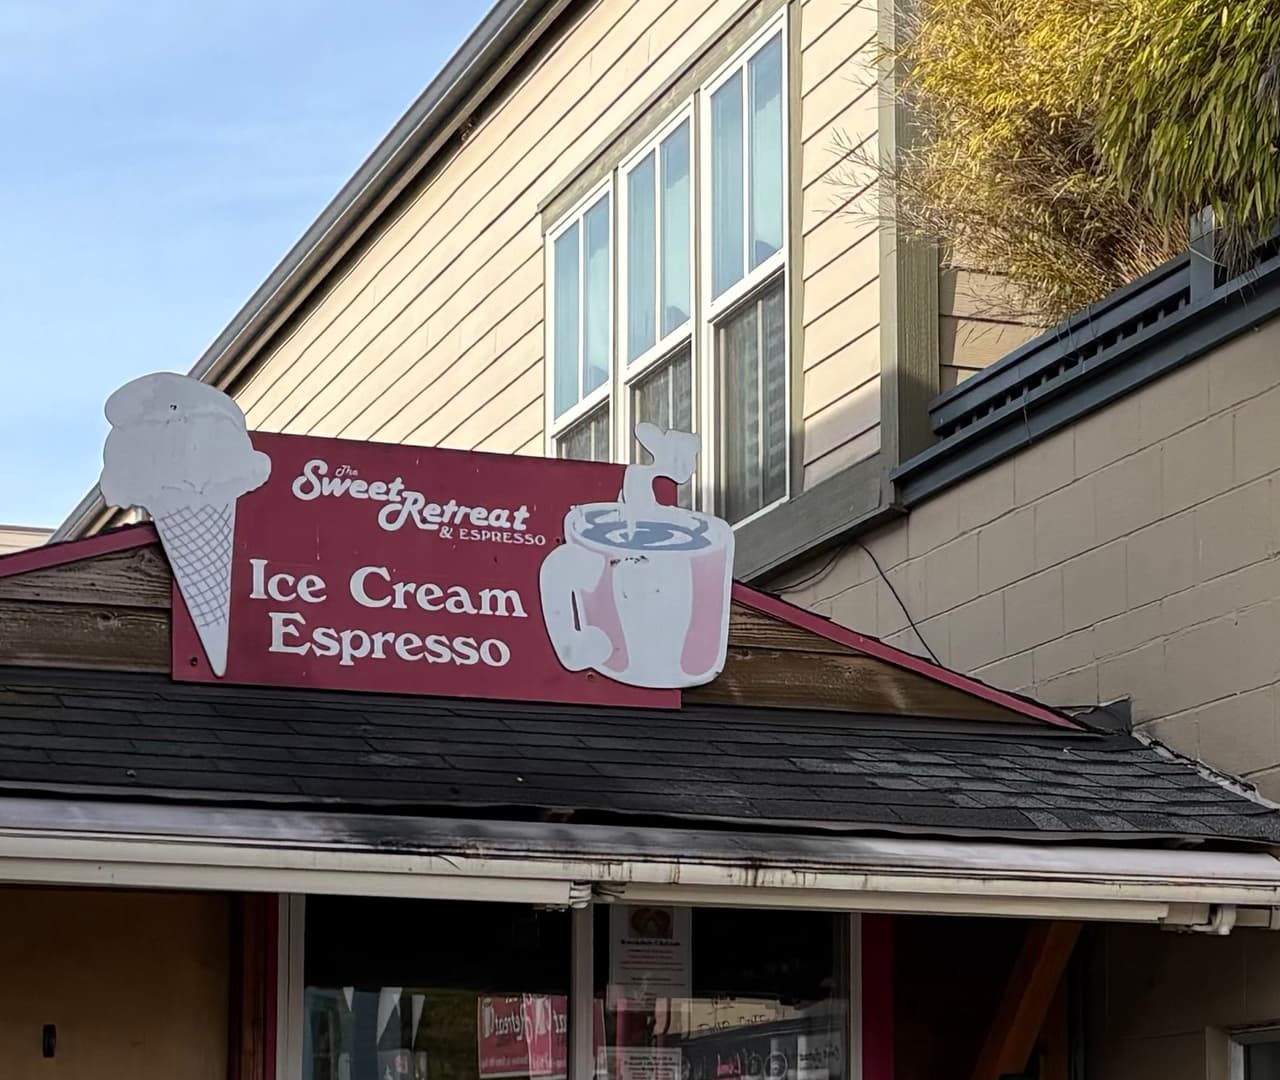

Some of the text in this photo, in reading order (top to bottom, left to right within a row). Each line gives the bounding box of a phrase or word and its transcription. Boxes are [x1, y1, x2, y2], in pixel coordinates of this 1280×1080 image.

[292, 459, 405, 502] Sweet
[335, 464, 359, 477] The
[377, 490, 529, 532] Retreat
[439, 525, 547, 546] & ESPRESSO
[249, 558, 528, 618] Ice Cream
[268, 611, 511, 668] Espresso
